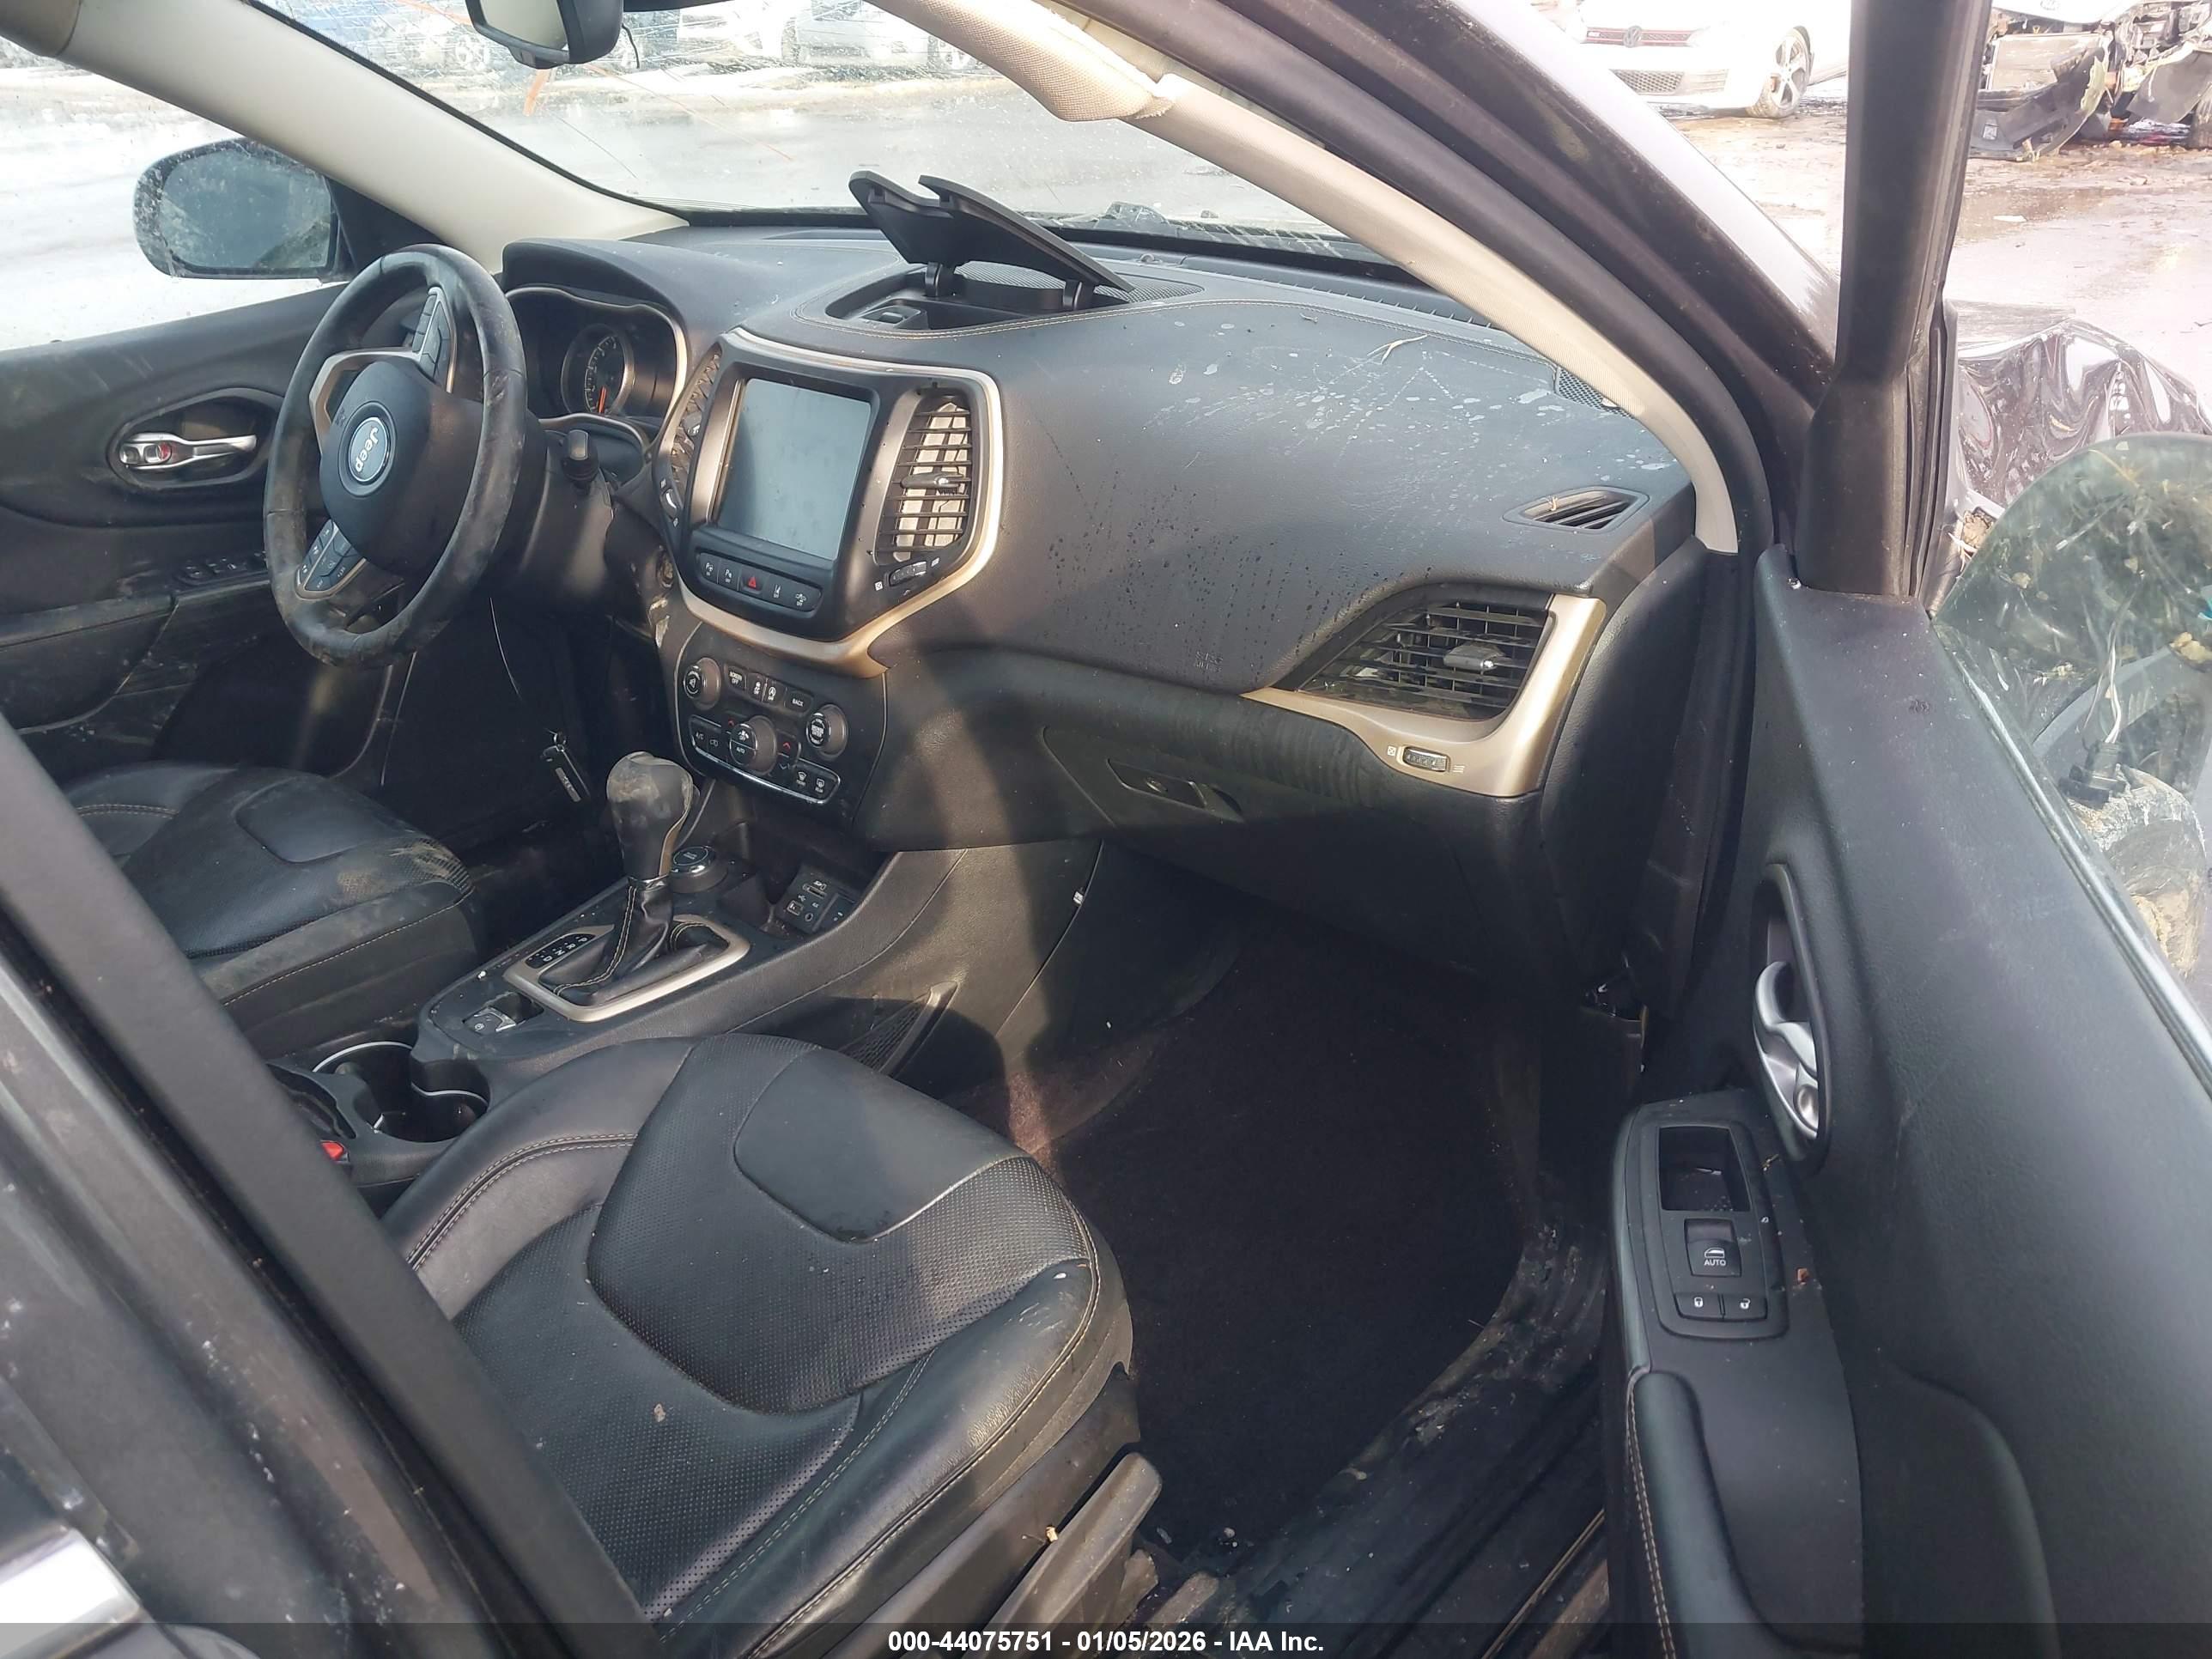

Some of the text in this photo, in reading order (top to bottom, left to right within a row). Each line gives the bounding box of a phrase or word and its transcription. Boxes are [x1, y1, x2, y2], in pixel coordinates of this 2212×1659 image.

[356, 427, 379, 472] Jeep
[792, 697, 804, 707] BACK
[696, 732, 704, 740] A/C
